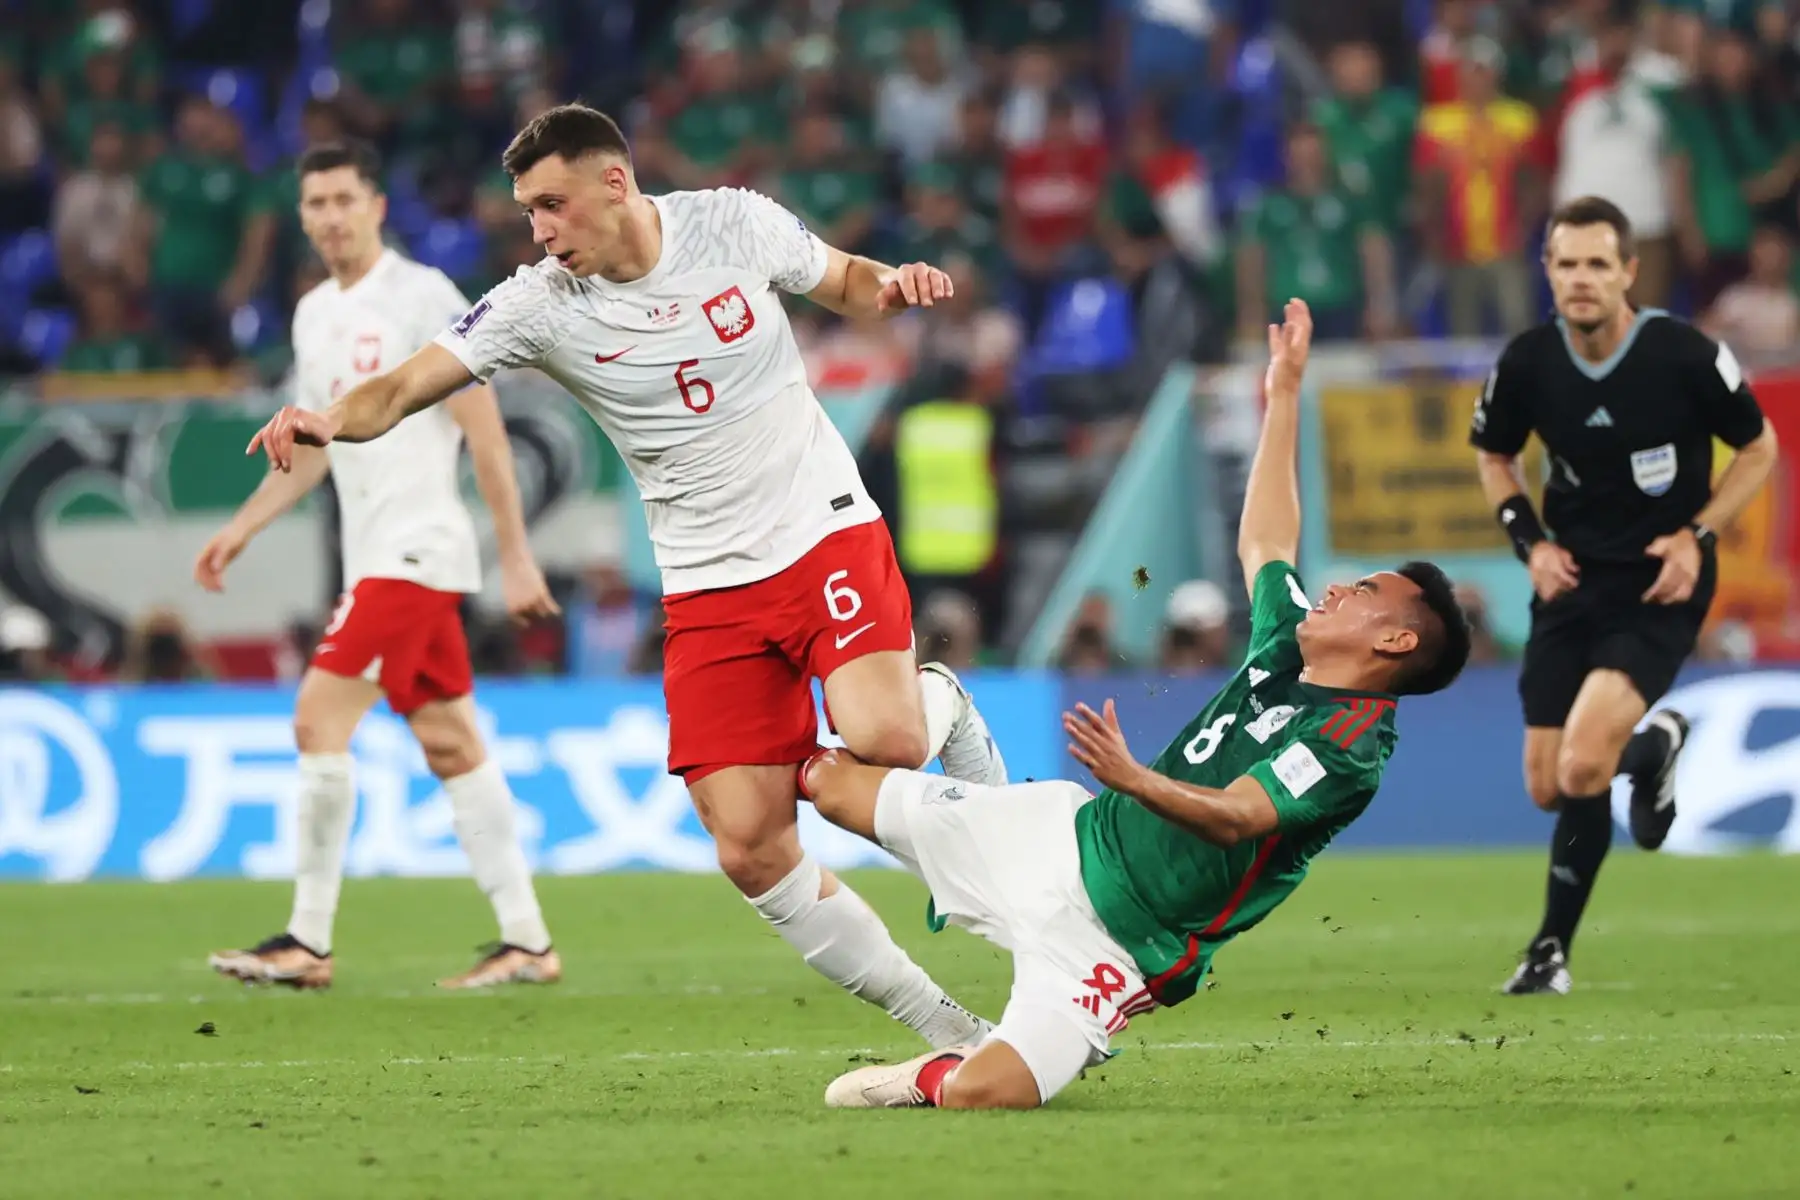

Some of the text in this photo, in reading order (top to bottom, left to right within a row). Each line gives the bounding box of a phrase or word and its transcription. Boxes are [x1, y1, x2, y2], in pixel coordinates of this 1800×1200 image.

[674, 358, 715, 414] 6
[823, 569, 862, 621] 6
[136, 702, 896, 880] 万达文
